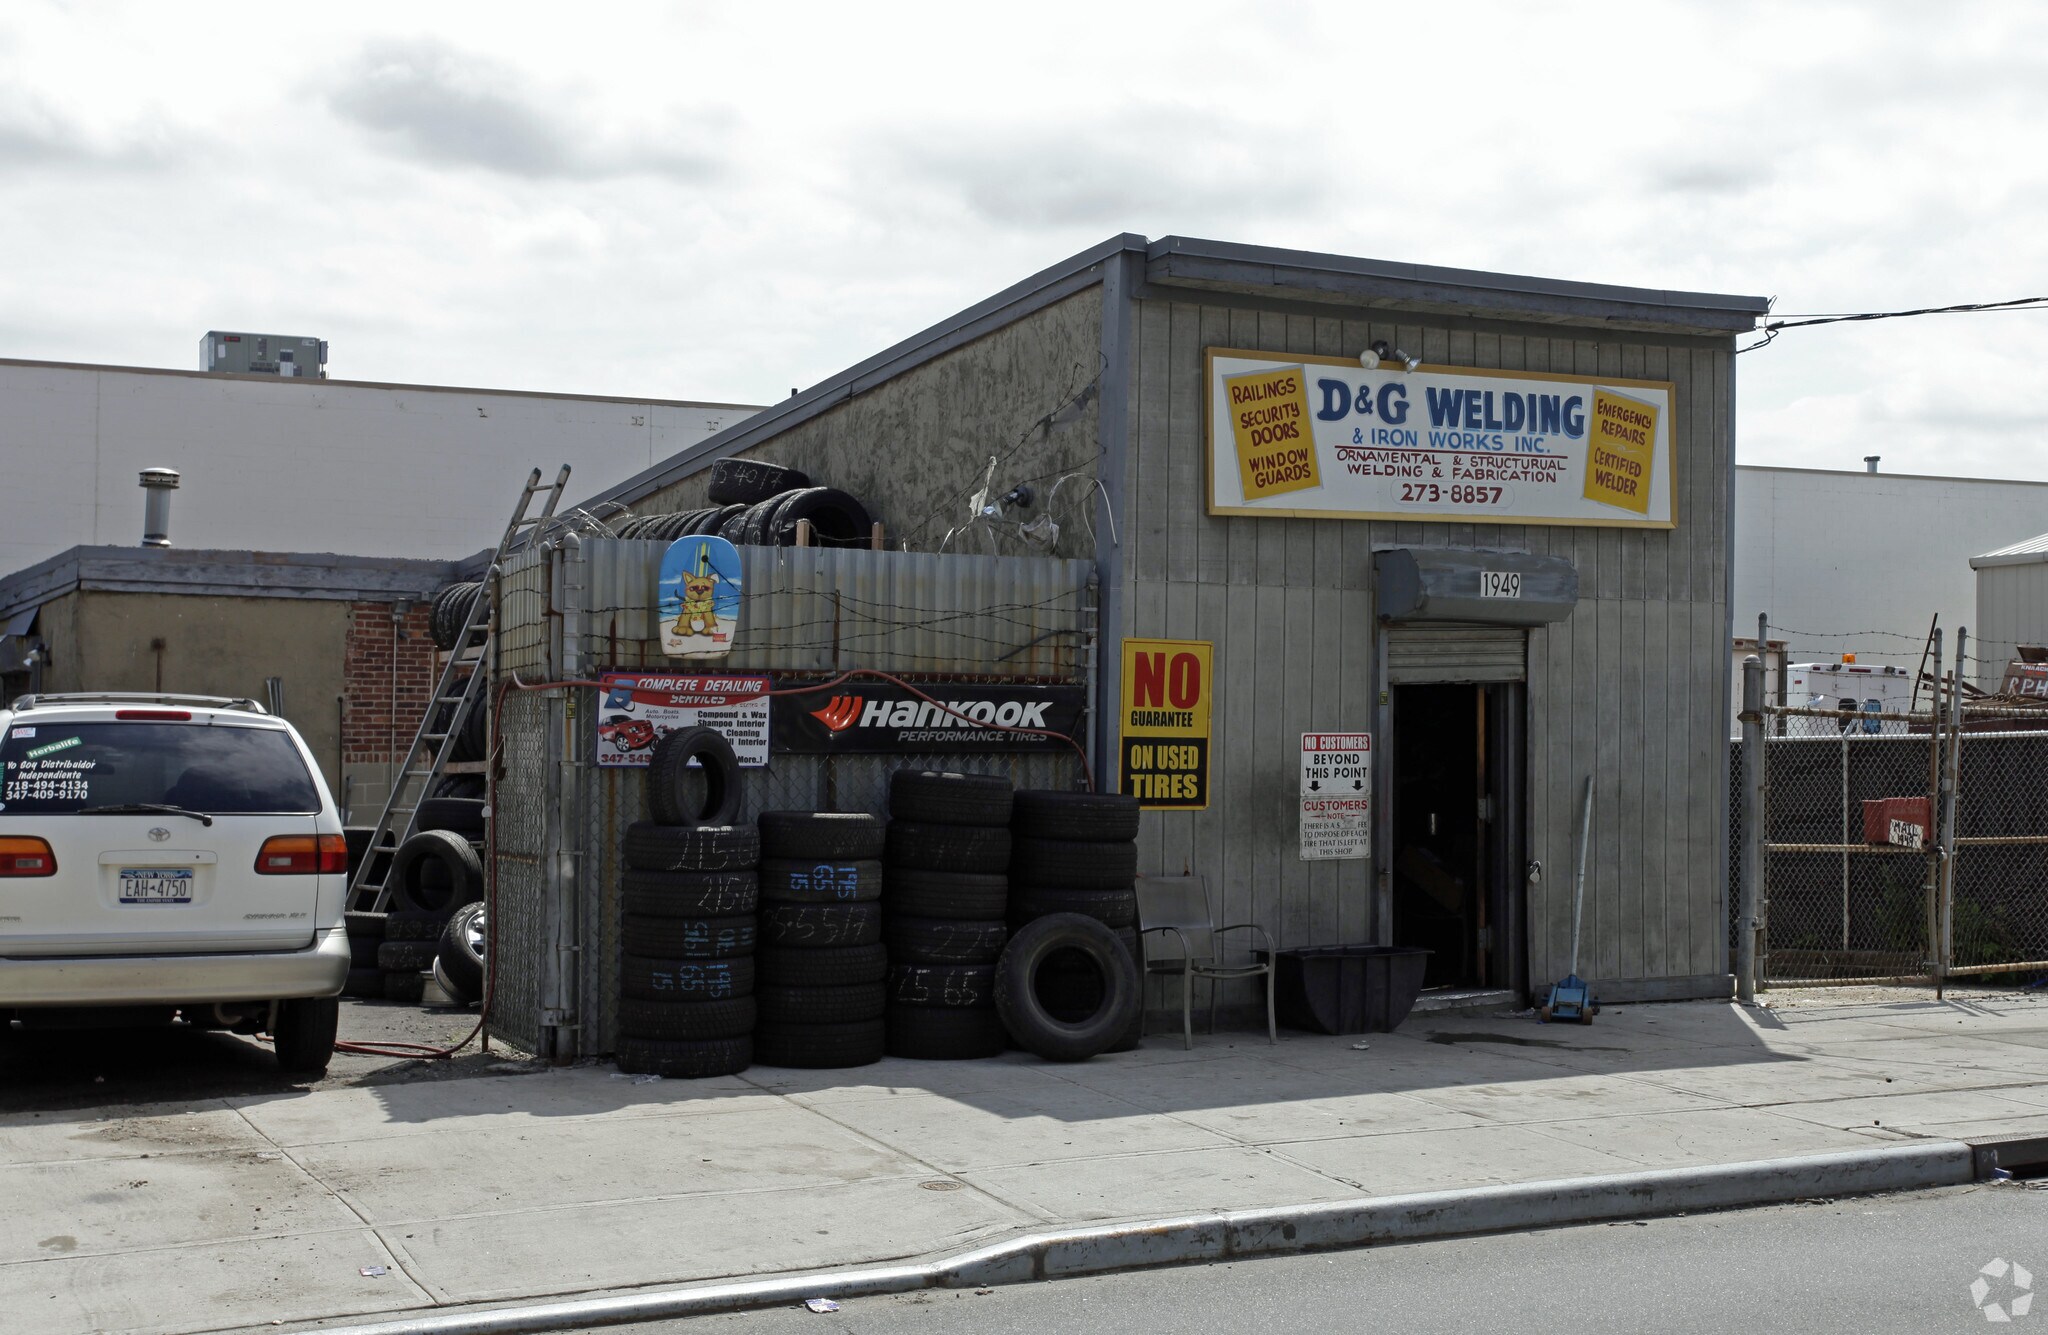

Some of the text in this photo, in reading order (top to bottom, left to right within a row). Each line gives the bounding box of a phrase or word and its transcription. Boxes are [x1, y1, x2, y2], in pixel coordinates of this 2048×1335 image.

[1232, 378, 1296, 404] RAILINGS
[1241, 402, 1300, 429] SECURITY
[1317, 378, 1585, 439] D&G WELDING
[1597, 398, 1652, 430] EMERGENCY
[1251, 421, 1299, 446] DOORS
[1352, 428, 1550, 453] & IRON WORKS INC.
[1601, 419, 1646, 446] REPAIRS
[1249, 448, 1308, 472] WINDOW
[1337, 449, 1566, 471] ORNAMENTAL & STRUCTURUAL
[1594, 447, 1642, 477] CERTIFIED
[1255, 462, 1311, 488] GUARDS
[1347, 464, 1556, 483] WELDING & FABRICATION
[1595, 468, 1638, 497] WELDER
[1401, 483, 1503, 504] 273-8857
[1484, 573, 1519, 597] 1949
[637, 678, 763, 693] COMPLETE DETAILING
[1133, 651, 1200, 709] NO
[697, 711, 738, 720] Compound
[750, 711, 767, 719] Wax
[697, 719, 765, 728] Shampoo Interior
[1131, 710, 1193, 728] GUARANTEE
[726, 729, 760, 737] Cleaning
[738, 738, 767, 746] Interior
[898, 730, 1047, 742] PERFORMANCE TIRES
[29, 739, 79, 758] Herbalife
[1304, 736, 1368, 750] NO CUSTOMERS
[7, 760, 96, 770] Yo Soy Distribuidor
[1130, 744, 1199, 770] ON USED
[1314, 754, 1360, 764] BEYOND
[18, 771, 82, 780] Independiente
[1305, 767, 1367, 778] THIS POINT
[6, 790, 88, 800] 347-409-9170
[7, 781, 89, 790] 718-494-4134
[1130, 773, 1198, 799] TIRES
[1304, 800, 1367, 811] CUSTOMERS
[1350, 829, 1367, 837] EACH
[1893, 821, 1918, 836] MAIL
[126, 879, 187, 897] EAH 4750
